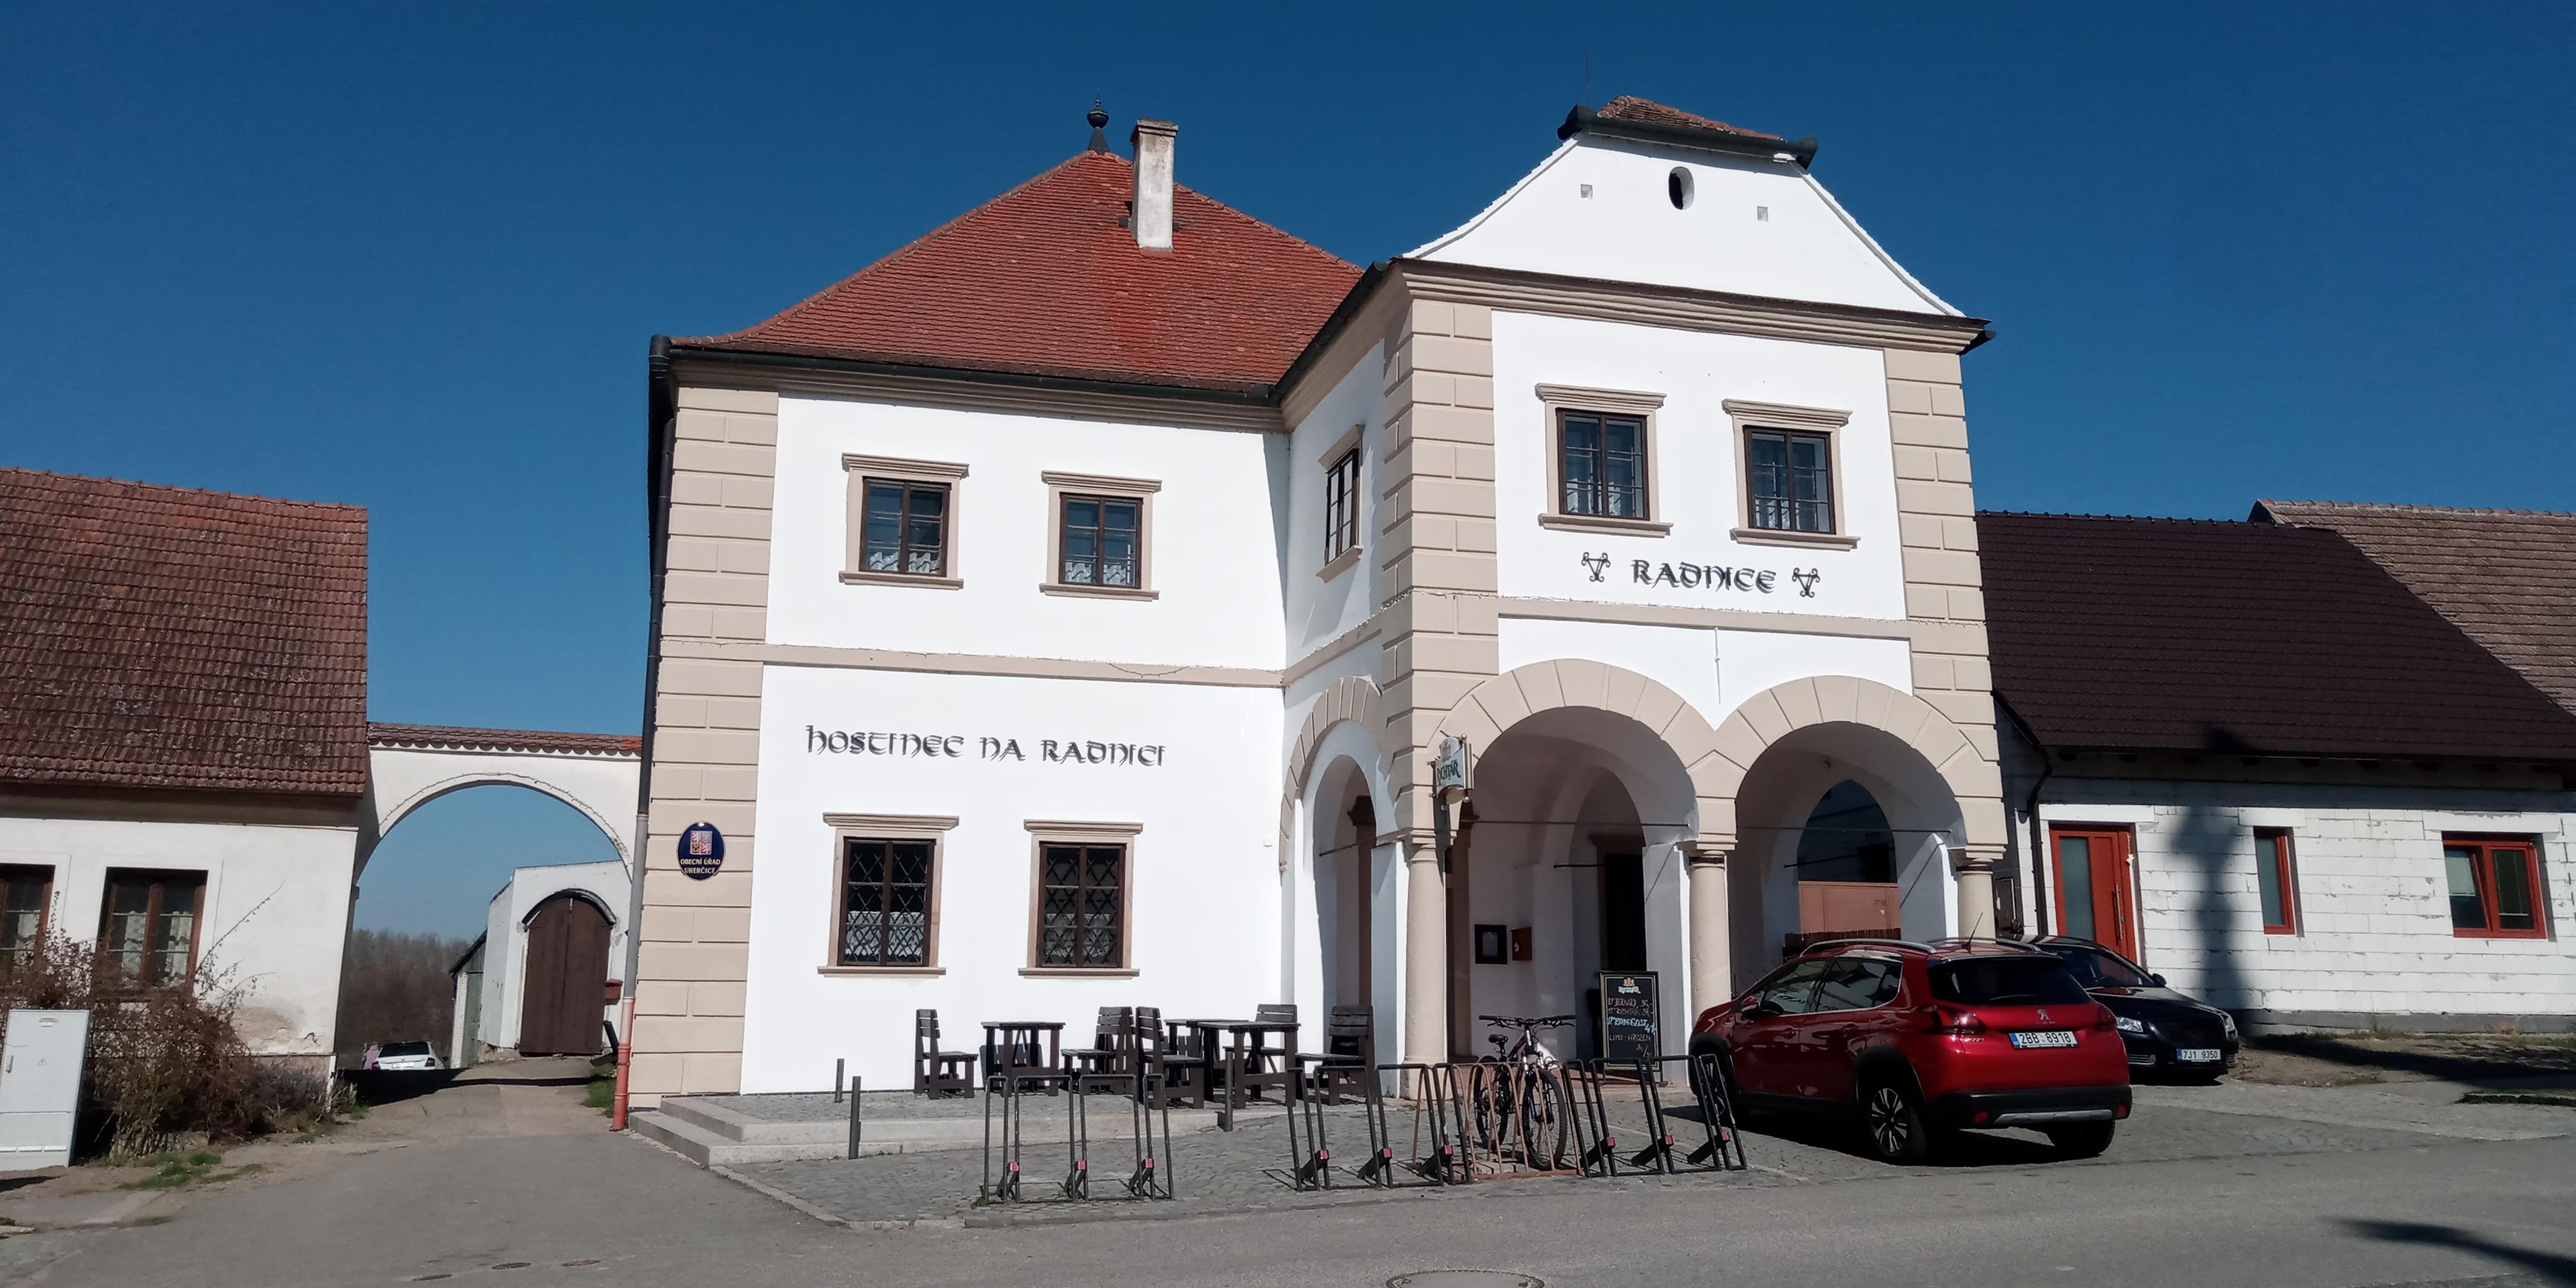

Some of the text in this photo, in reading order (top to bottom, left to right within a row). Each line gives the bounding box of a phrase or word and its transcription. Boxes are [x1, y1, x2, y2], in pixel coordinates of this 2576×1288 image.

[1631, 559, 1777, 594] RADNICE
[805, 725, 1166, 767] HOSTINEC NA RADNICI
[2045, 1033, 2071, 1043] 8918
[2202, 1050, 2218, 1058] 9350
